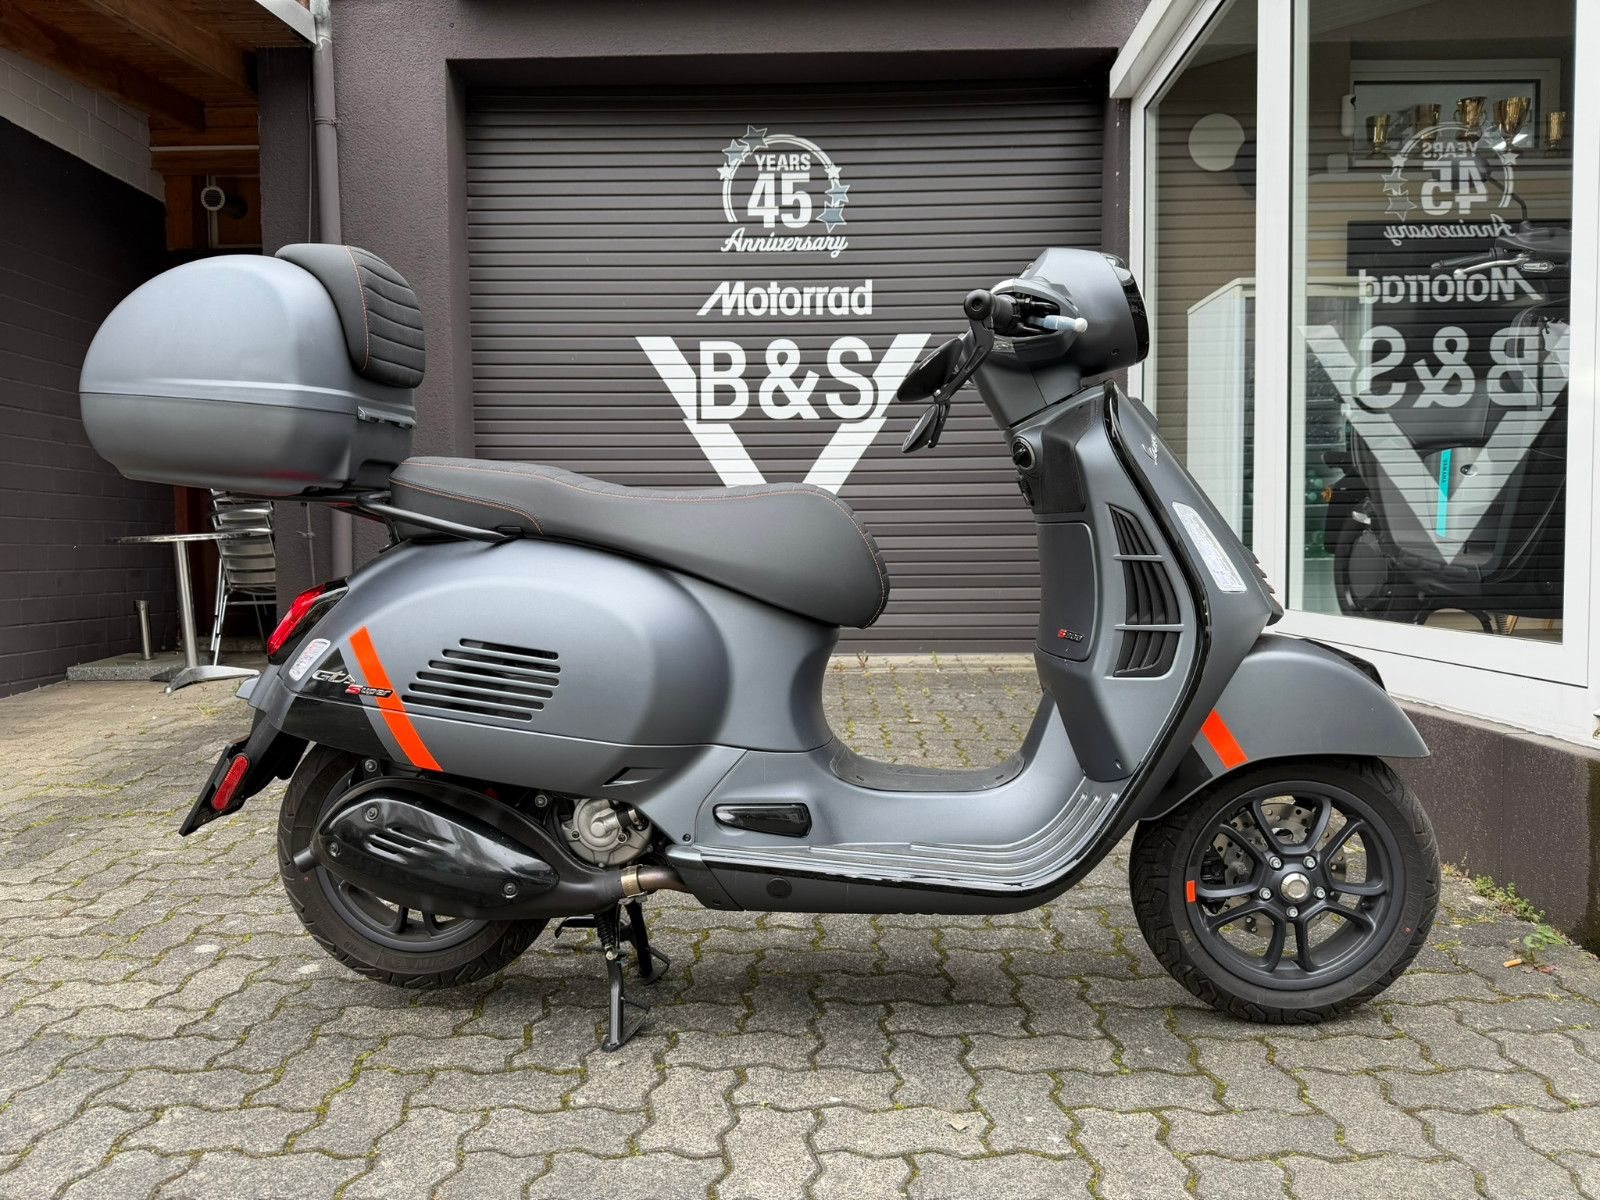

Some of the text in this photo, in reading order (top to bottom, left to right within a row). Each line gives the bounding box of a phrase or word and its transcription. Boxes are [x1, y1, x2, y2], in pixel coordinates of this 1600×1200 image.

[755, 154, 811, 171] YEARS
[747, 173, 812, 229] 45
[721, 227, 848, 257] Anniversary
[696, 279, 873, 316] Motorrad
[699, 336, 874, 420] B&S
